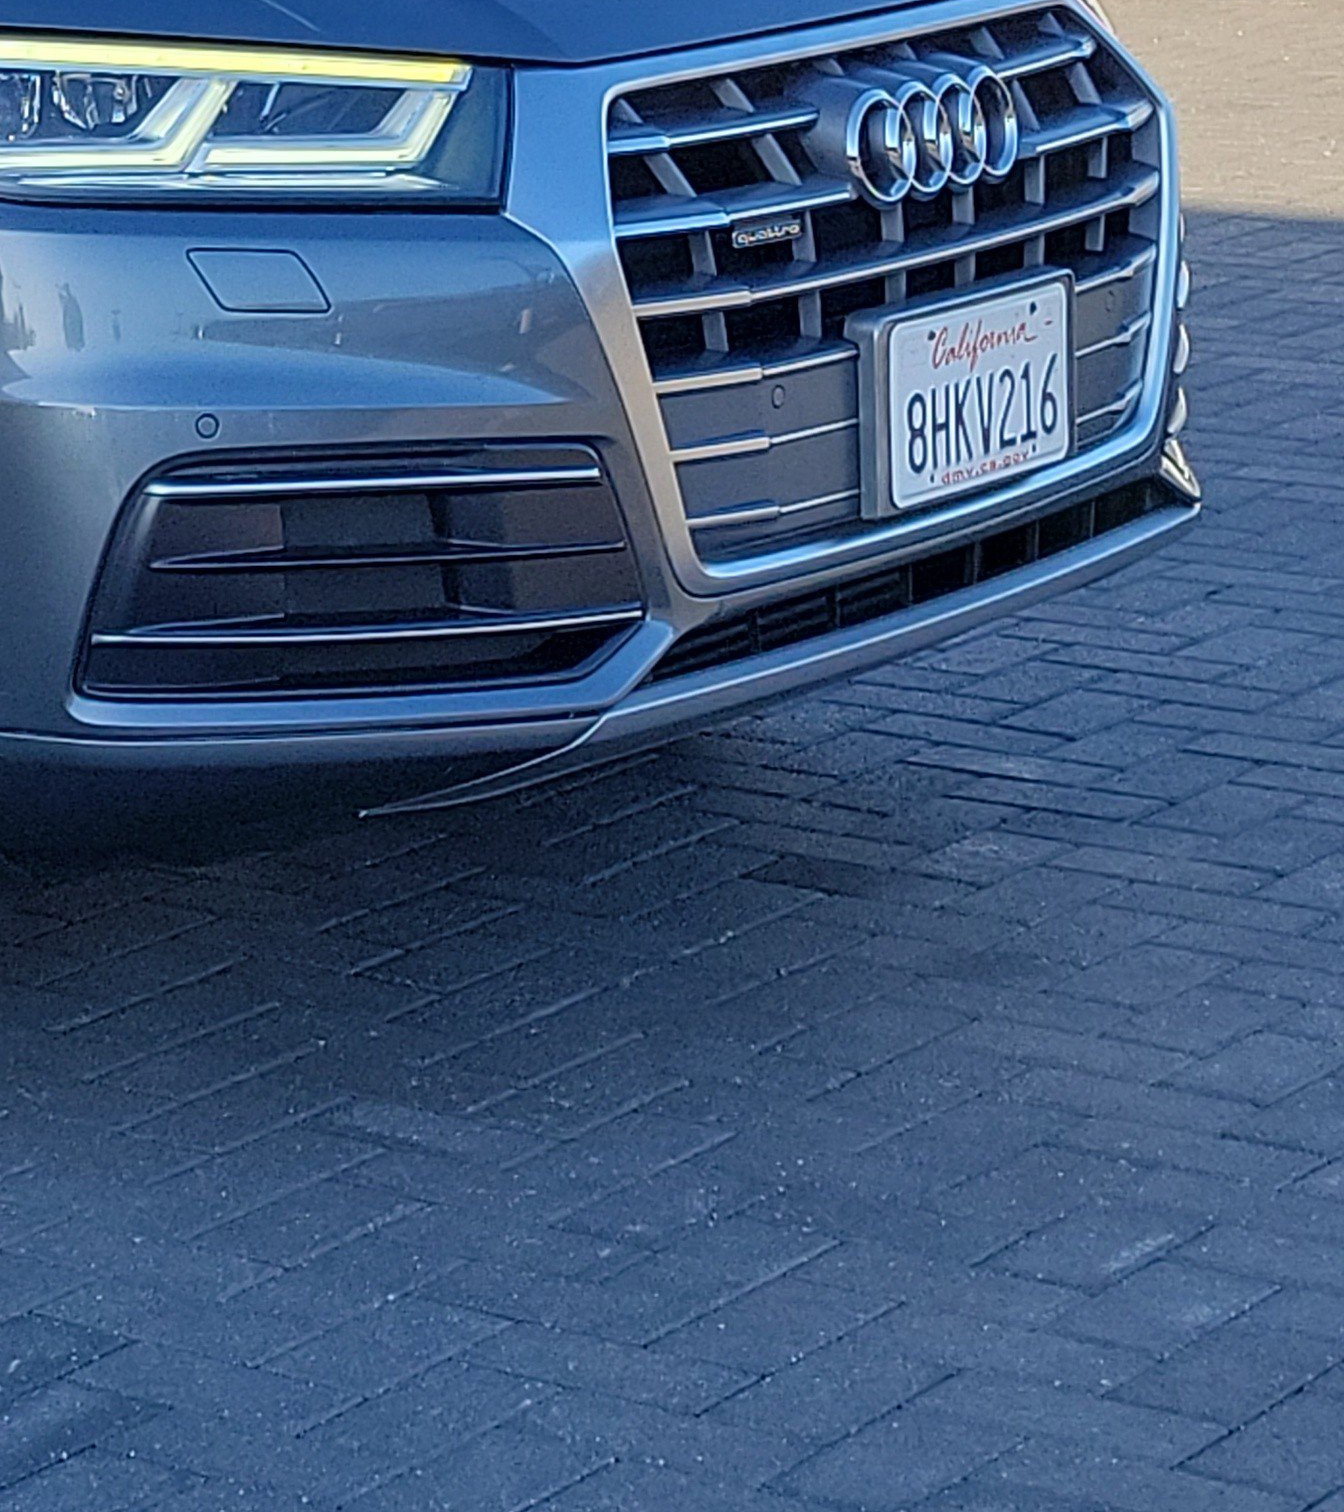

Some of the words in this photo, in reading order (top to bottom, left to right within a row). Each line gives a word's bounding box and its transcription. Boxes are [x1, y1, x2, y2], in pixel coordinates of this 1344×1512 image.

[932, 318, 1037, 373] California
[906, 352, 1059, 475] 8HKV216
[941, 449, 1030, 486] dmv.ca.gov
